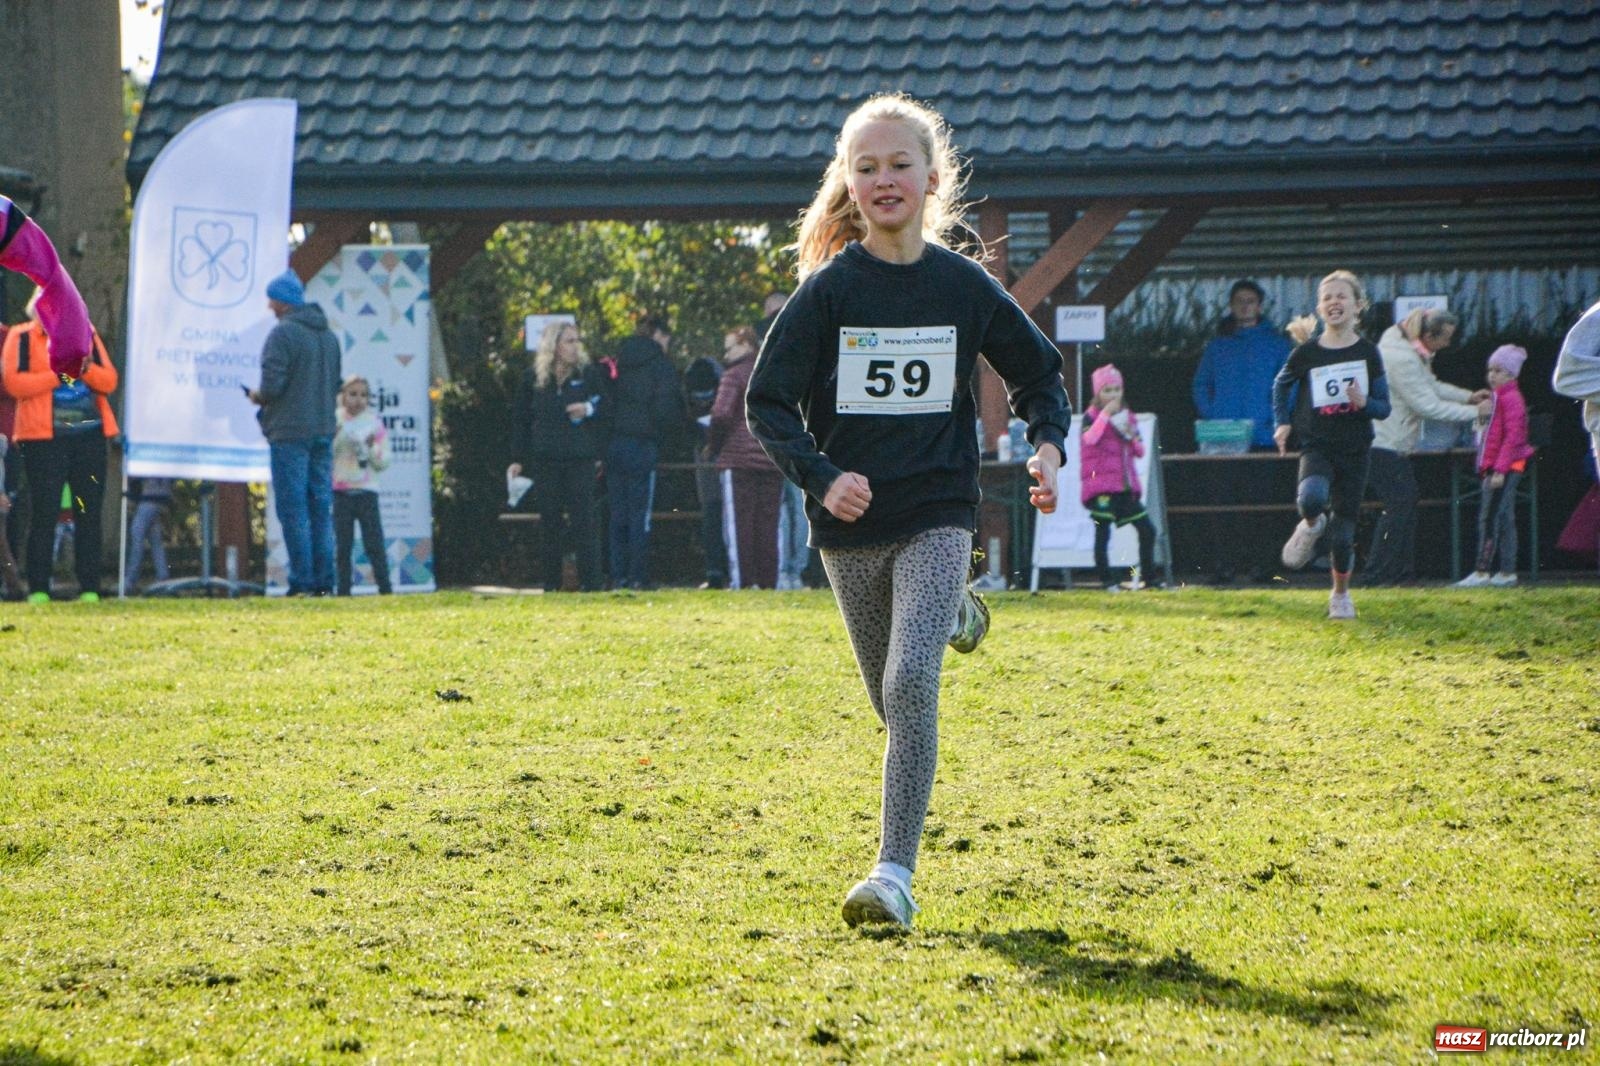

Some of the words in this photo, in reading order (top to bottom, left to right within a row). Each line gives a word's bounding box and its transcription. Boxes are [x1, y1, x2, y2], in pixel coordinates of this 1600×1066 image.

[181, 326, 240, 343] GMINA
[884, 336, 952, 346] www.personalbest.pl
[865, 360, 931, 398] 59
